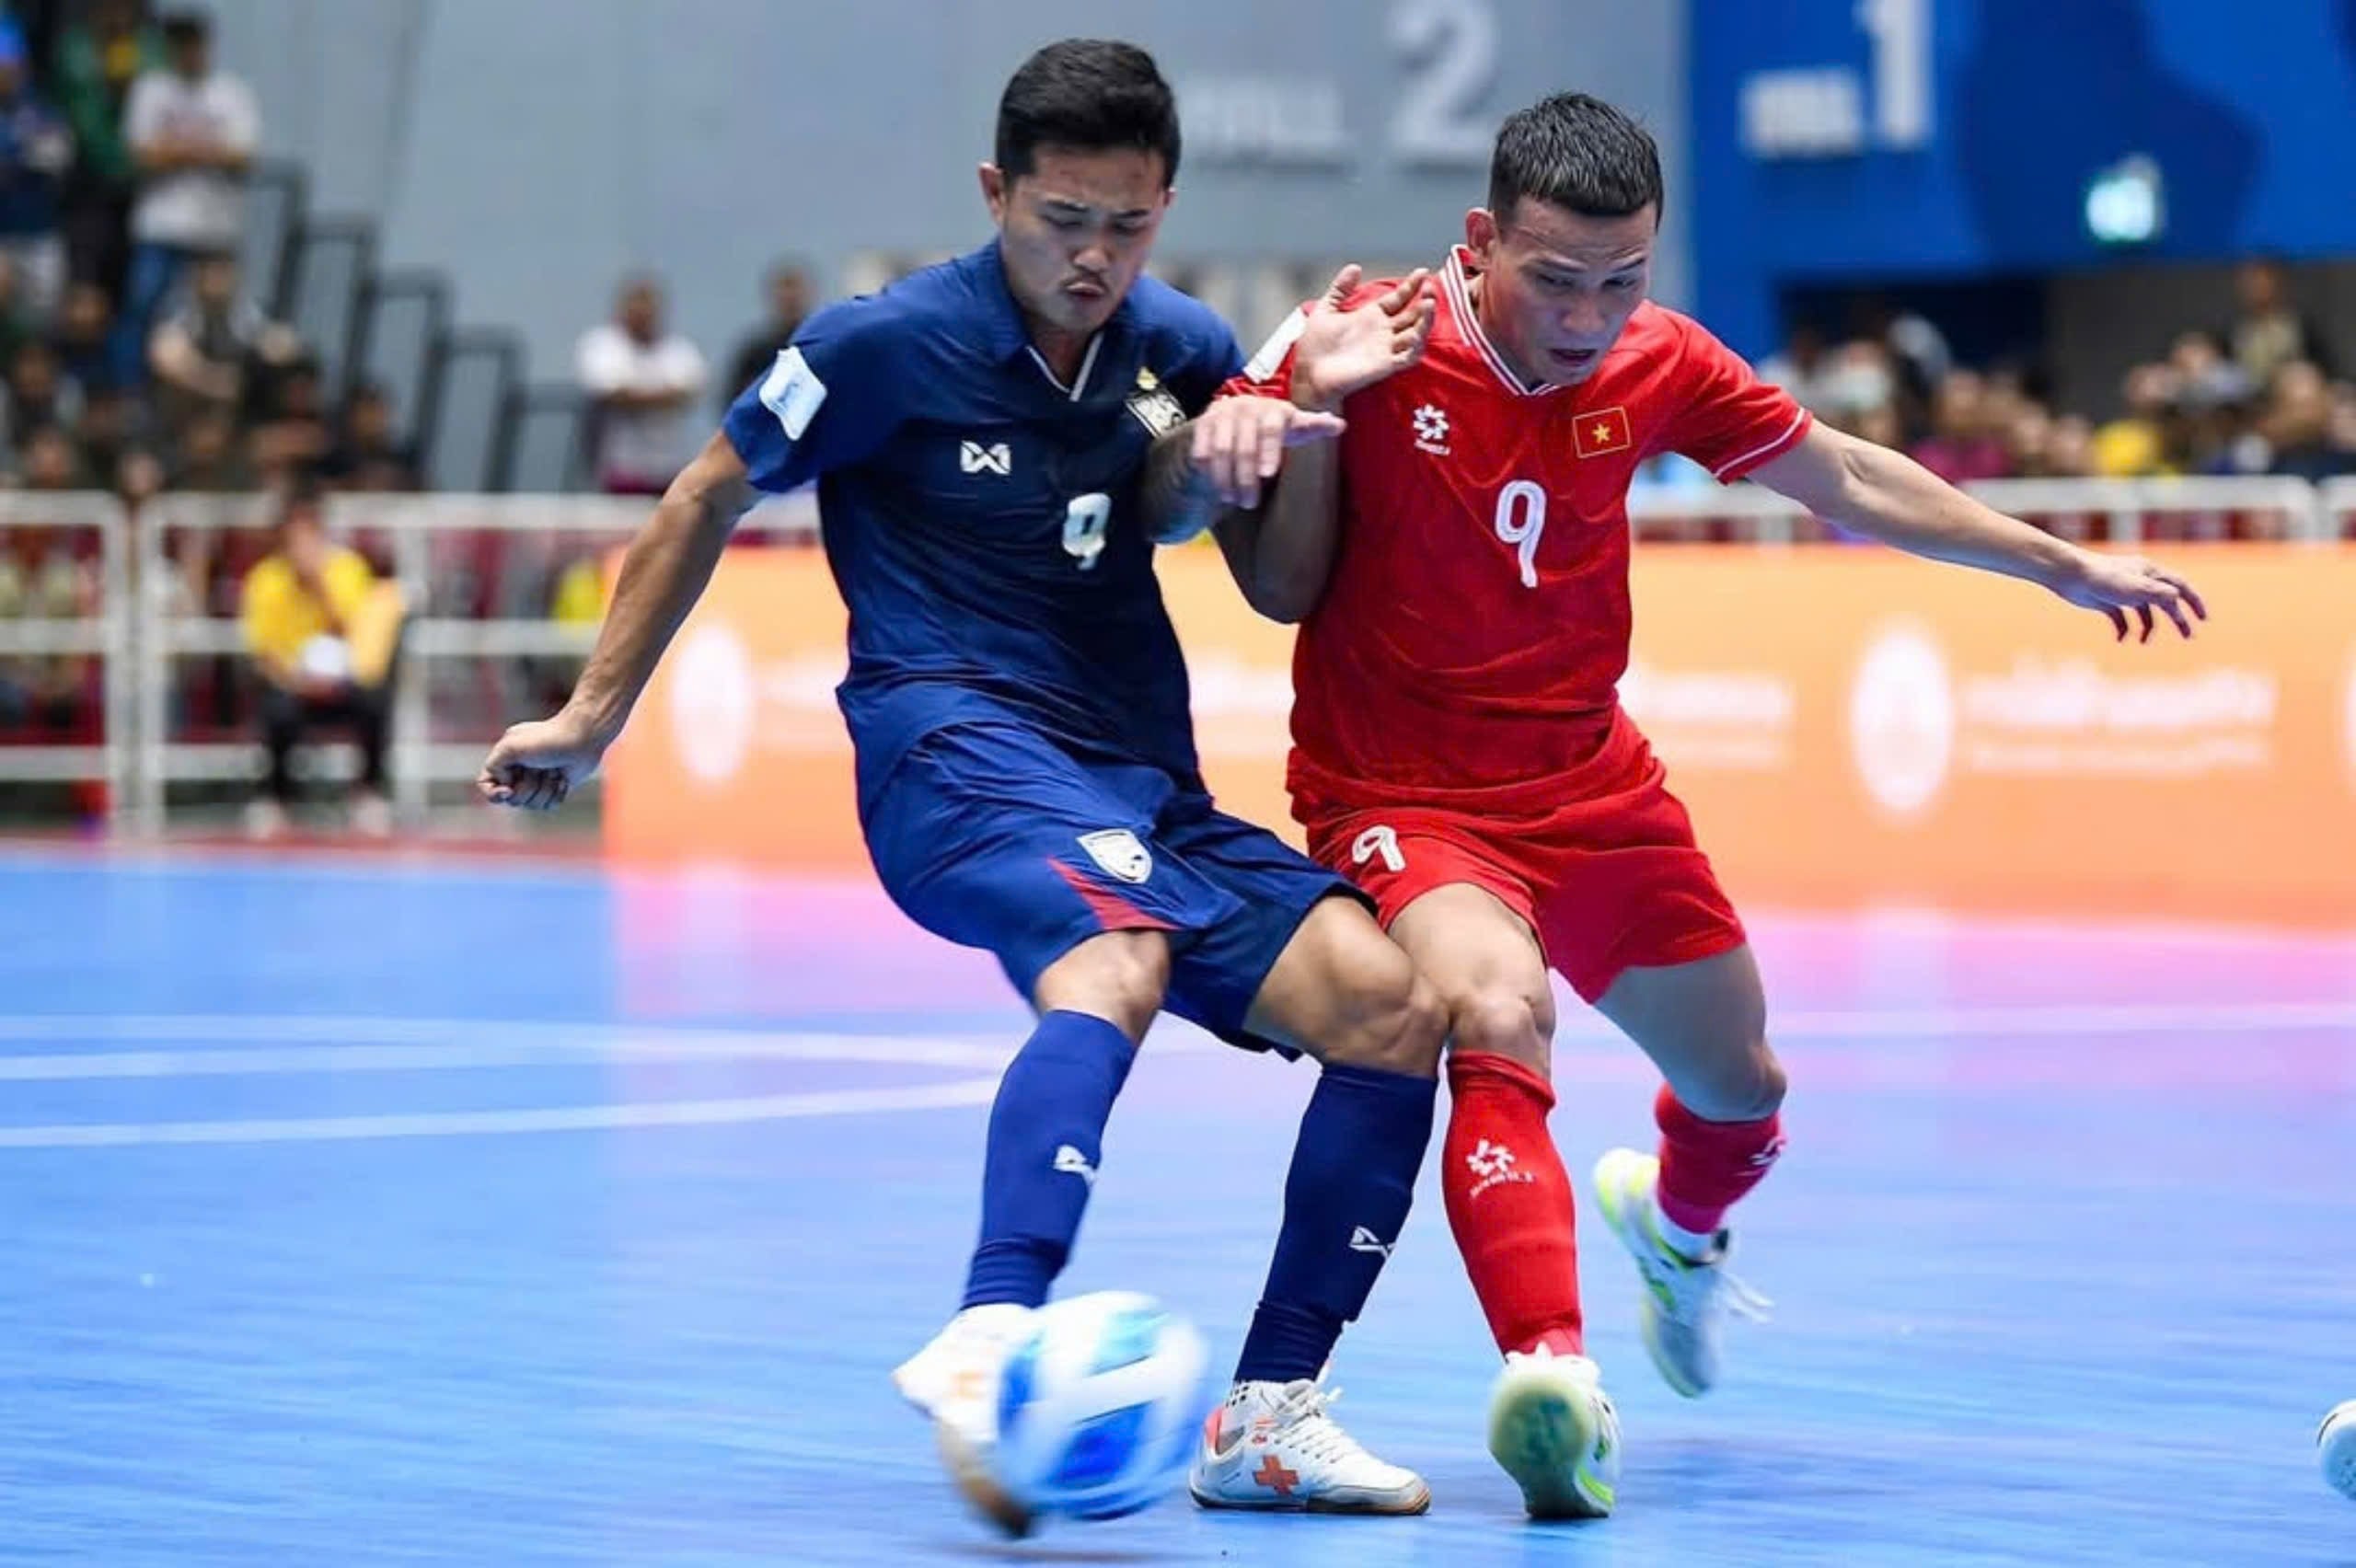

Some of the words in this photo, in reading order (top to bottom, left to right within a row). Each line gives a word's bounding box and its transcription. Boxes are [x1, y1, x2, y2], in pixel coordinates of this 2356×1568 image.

[1391, 0, 1499, 152] 2
[1856, 0, 1932, 146] 1
[1062, 492, 1112, 571] 9
[1495, 478, 1548, 589] 9
[1351, 824, 1406, 871] 9
